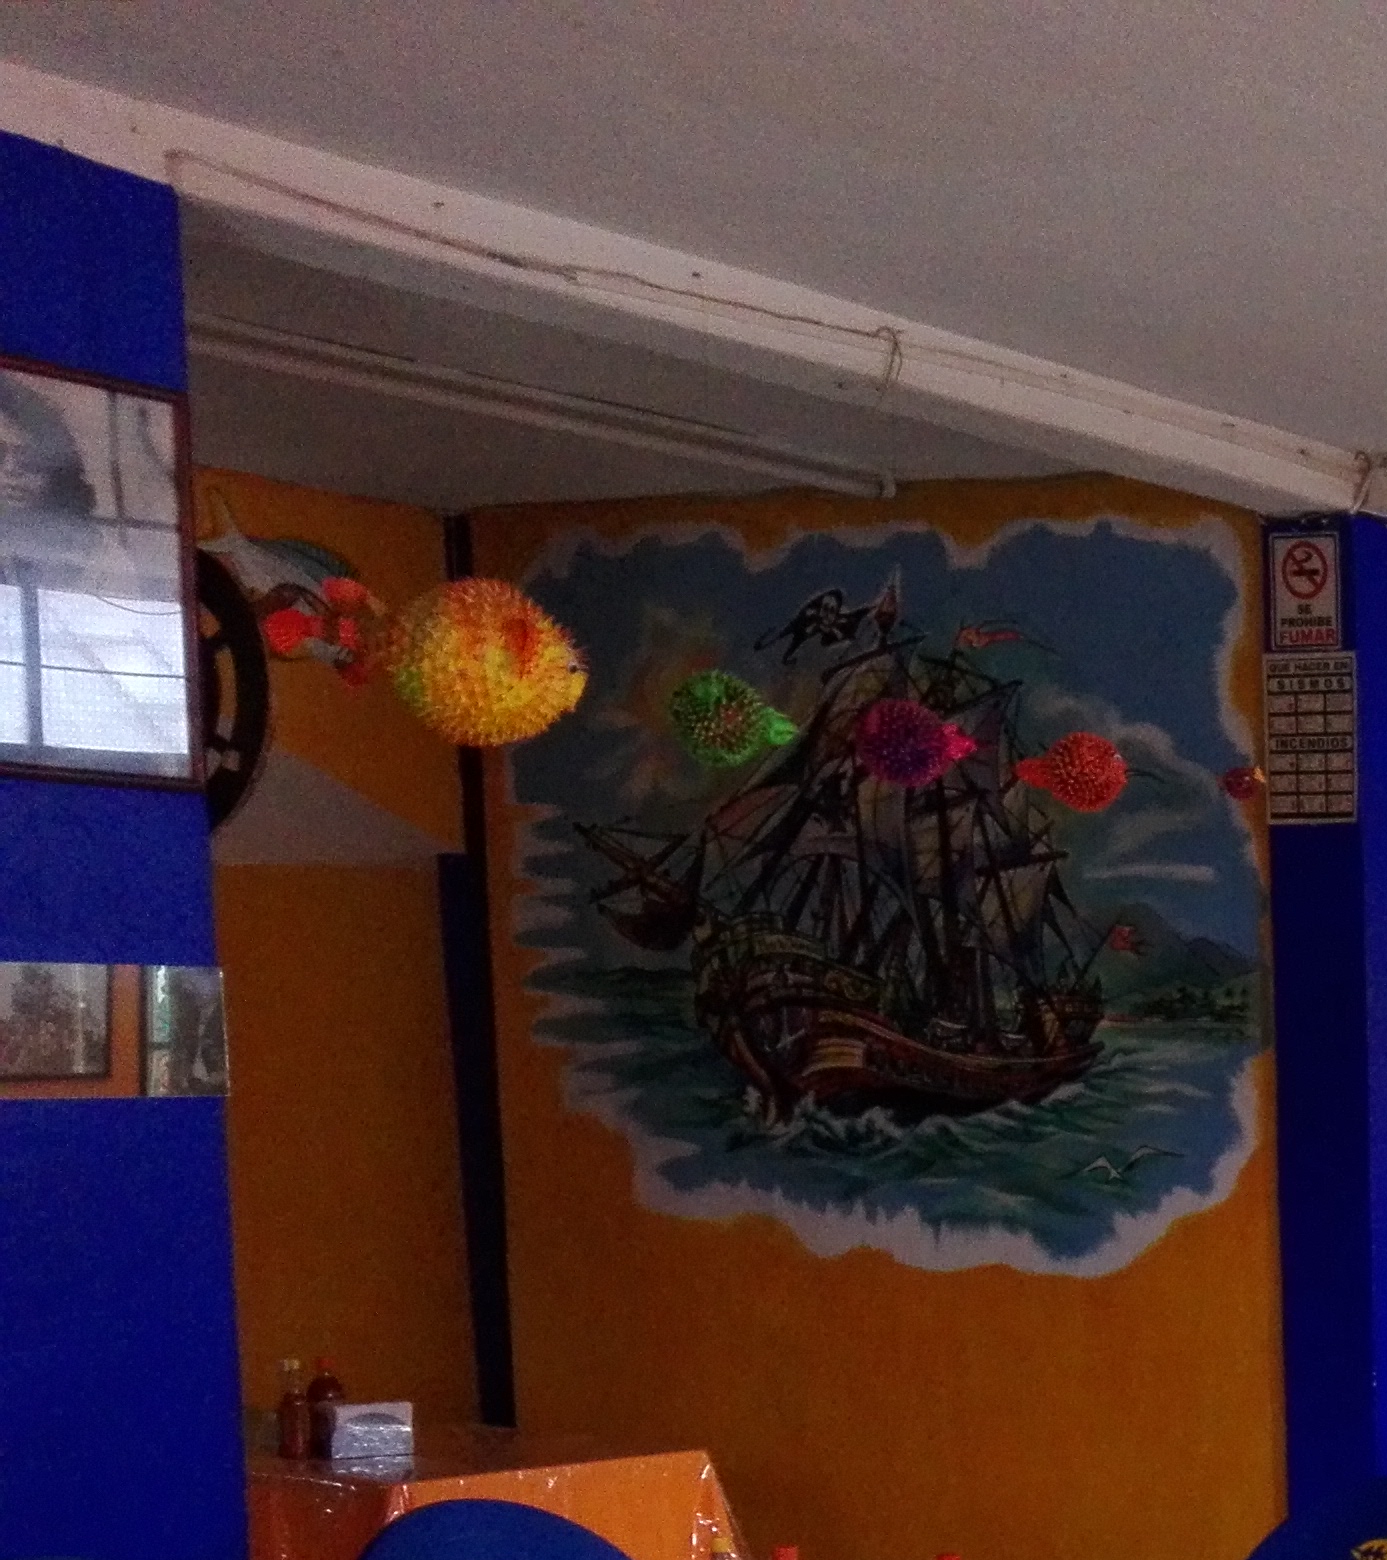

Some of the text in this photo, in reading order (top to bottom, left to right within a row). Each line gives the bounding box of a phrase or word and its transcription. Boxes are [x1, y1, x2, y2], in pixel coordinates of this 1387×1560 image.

[1297, 604, 1312, 615] SE
[1281, 616, 1333, 628] PROHIBE
[1280, 628, 1336, 644] FUMAR
[1277, 677, 1345, 690] SISMOS
[1275, 737, 1348, 750] INCENDIOS
